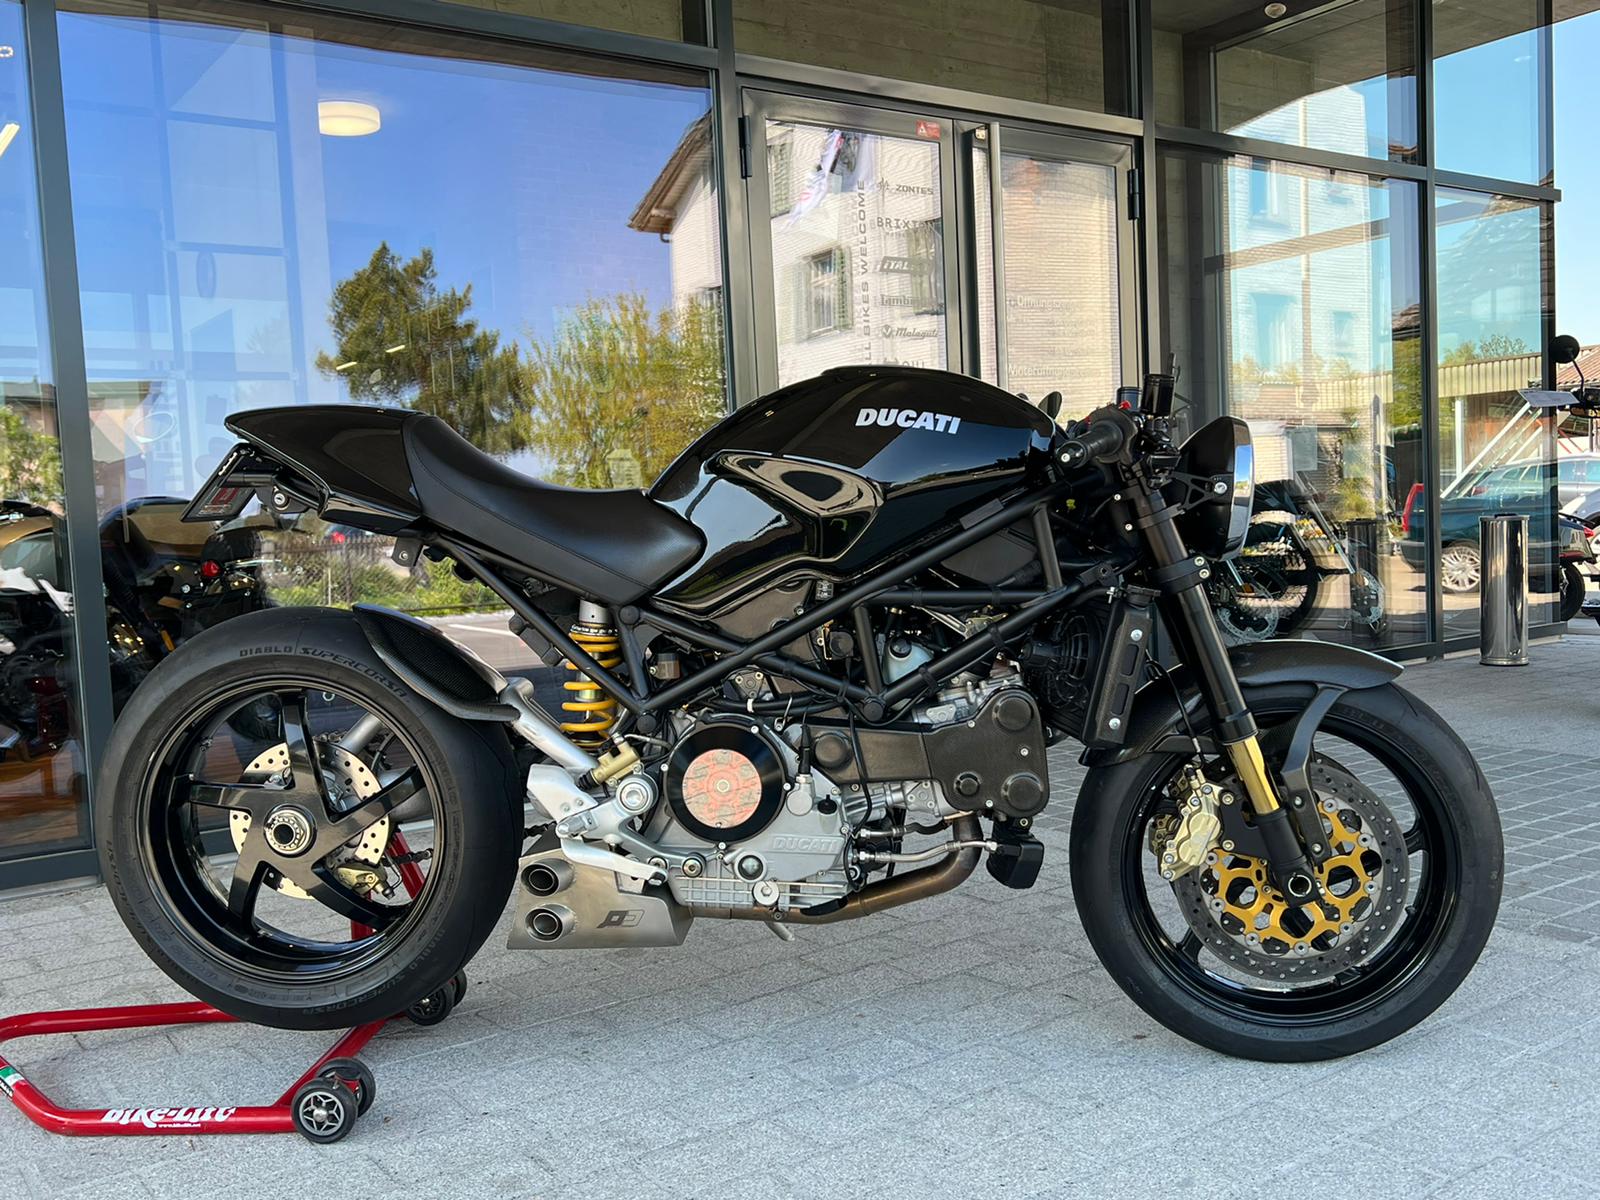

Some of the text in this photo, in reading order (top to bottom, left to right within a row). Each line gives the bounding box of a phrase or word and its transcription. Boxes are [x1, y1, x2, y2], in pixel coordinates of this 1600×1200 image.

[896, 184, 934, 196] ZONTES
[857, 180, 872, 365] LL BIKES WELCOME
[855, 408, 961, 435] DUCATI
[239, 645, 408, 698] DIABLO SUPERCORSA
[773, 836, 839, 853] DUCATI
